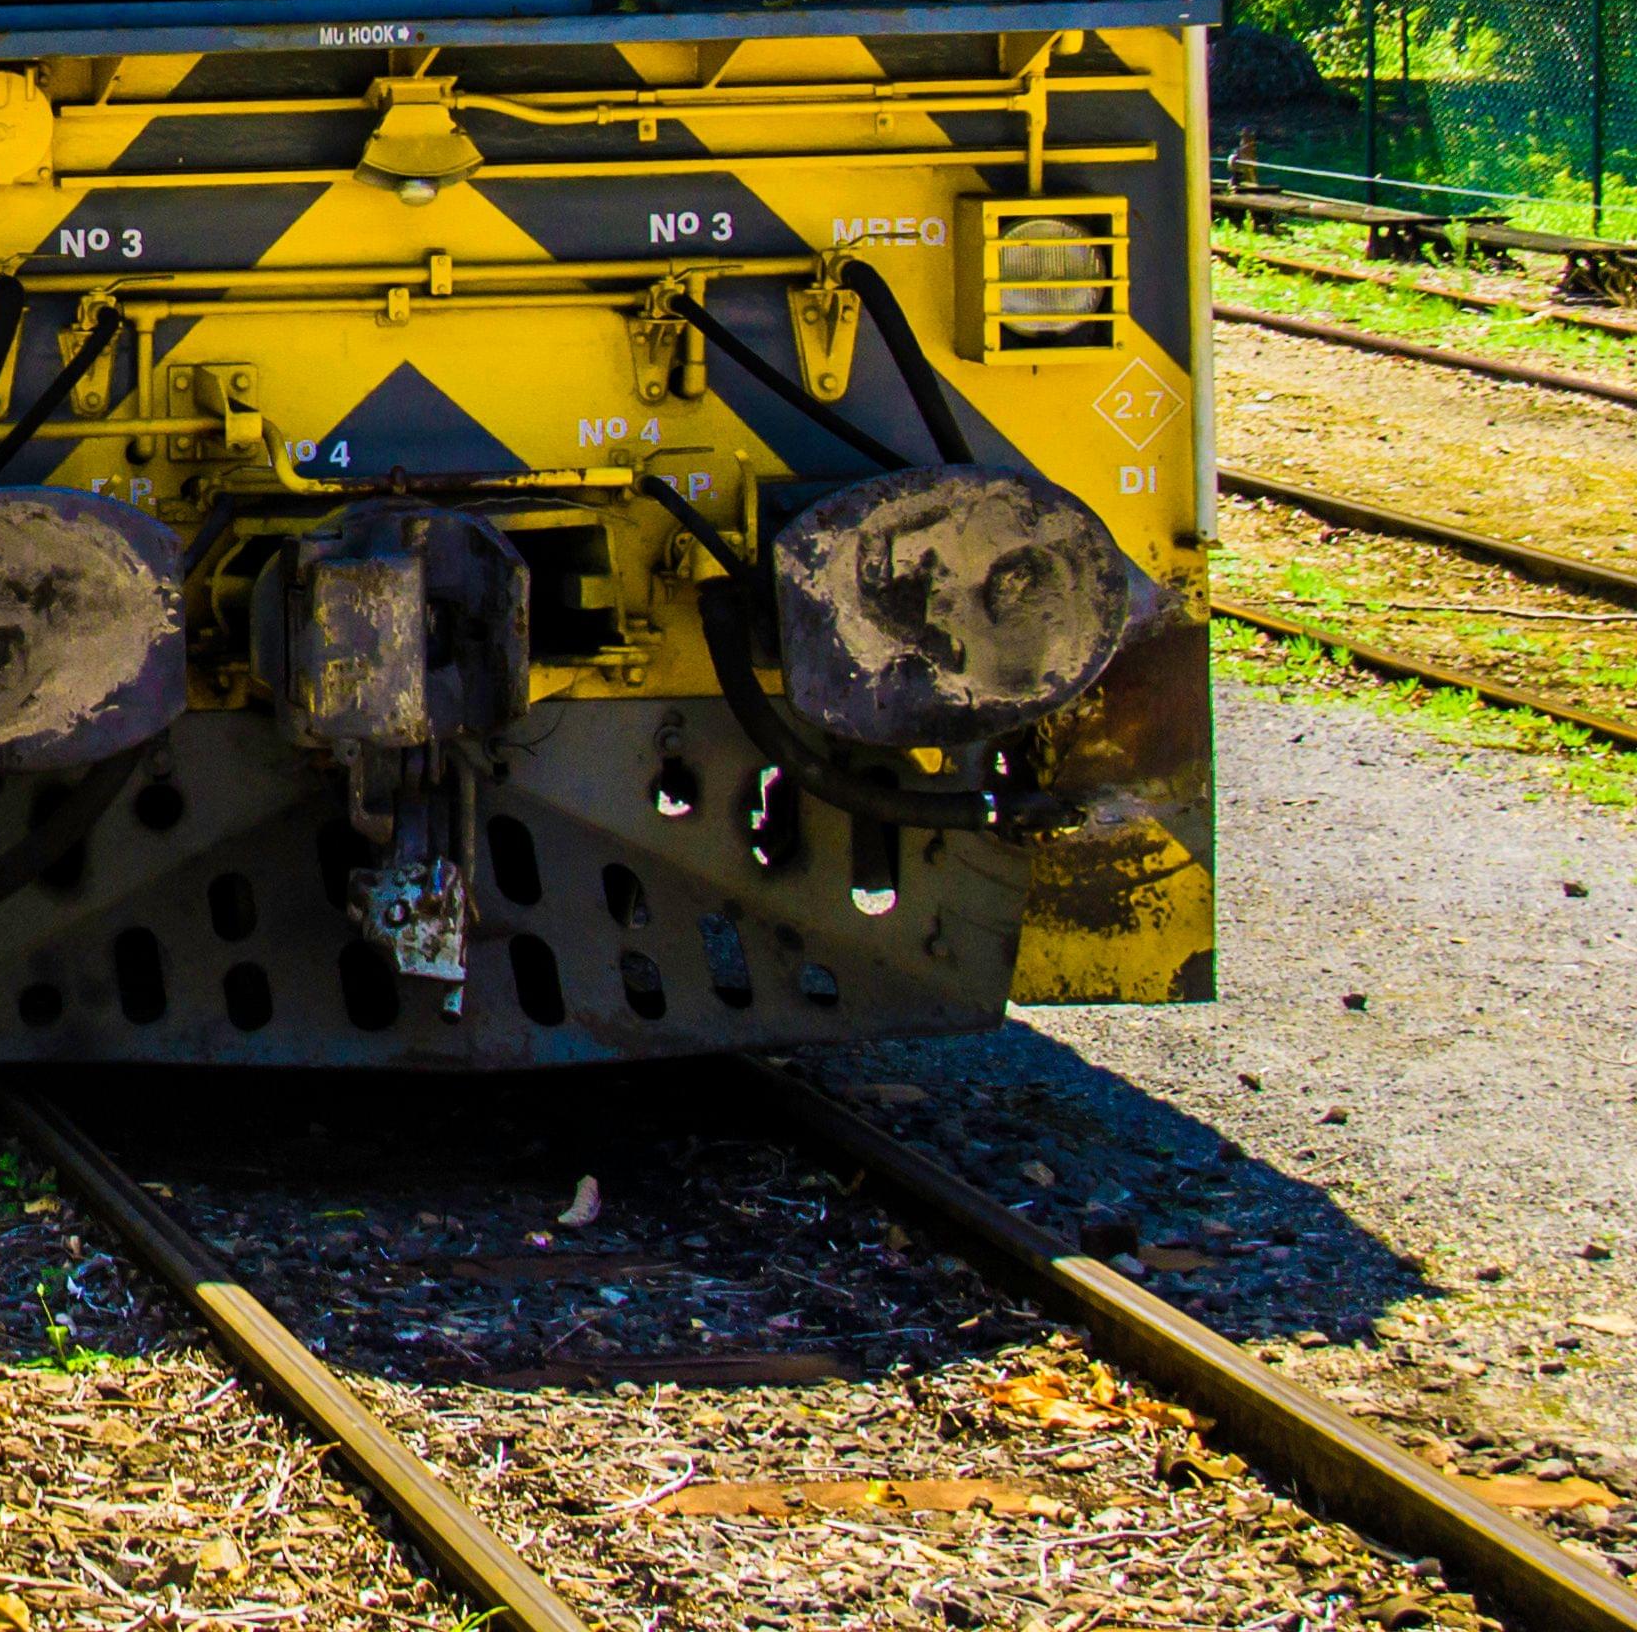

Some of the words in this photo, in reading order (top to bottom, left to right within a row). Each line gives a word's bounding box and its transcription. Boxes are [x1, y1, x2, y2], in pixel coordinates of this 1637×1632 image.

[320, 27, 344, 45] MU
[349, 26, 394, 44] HOOK
[712, 212, 733, 241] 3
[832, 216, 946, 246] MREQ
[122, 228, 143, 258] 3
[1114, 390, 1165, 419] 2.7
[640, 418, 661, 445] 4
[329, 440, 351, 468] 4
[1119, 464, 1158, 494] DI
